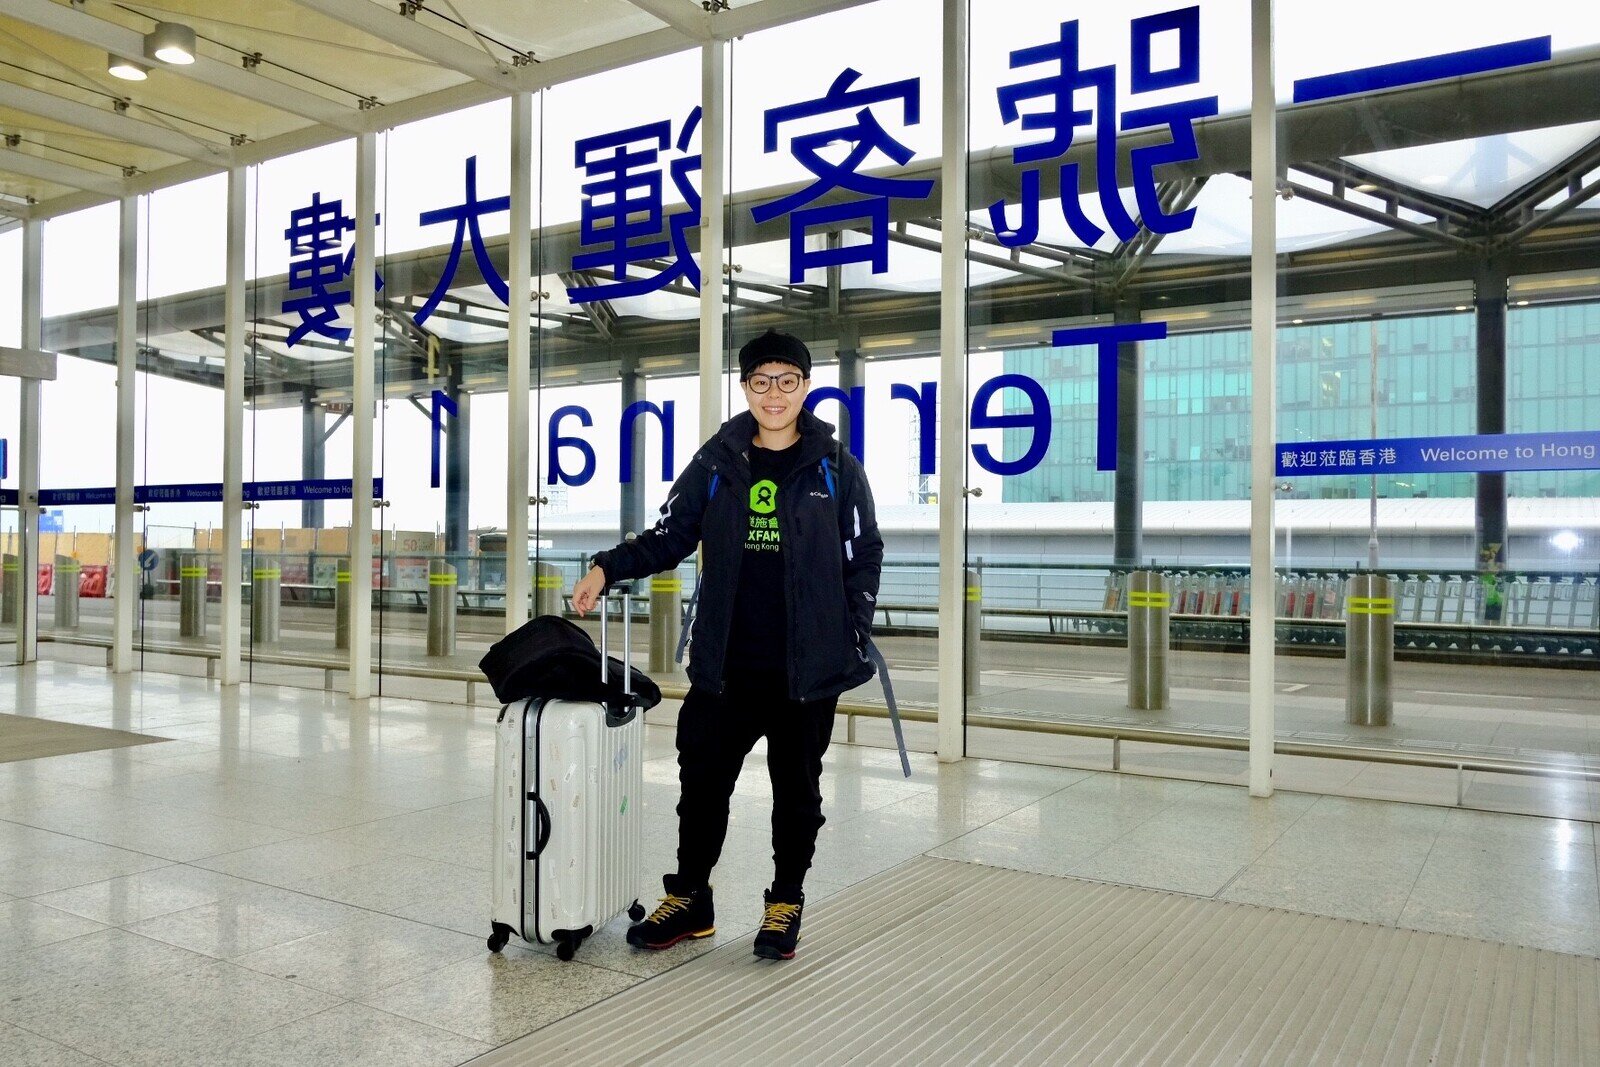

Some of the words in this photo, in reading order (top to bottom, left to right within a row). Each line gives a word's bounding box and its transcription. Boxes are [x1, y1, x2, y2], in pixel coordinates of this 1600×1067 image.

[1280, 447, 1397, 468] 歡迎蒞臨香港
[1420, 447, 1509, 462] Welcome
[1514, 446, 1534, 459] to
[1541, 443, 1595, 459] Hong
[186, 489, 211, 497] Welcome
[303, 486, 333, 494] Welcome
[747, 530, 780, 542] XFAM
[761, 542, 779, 552] Kong
